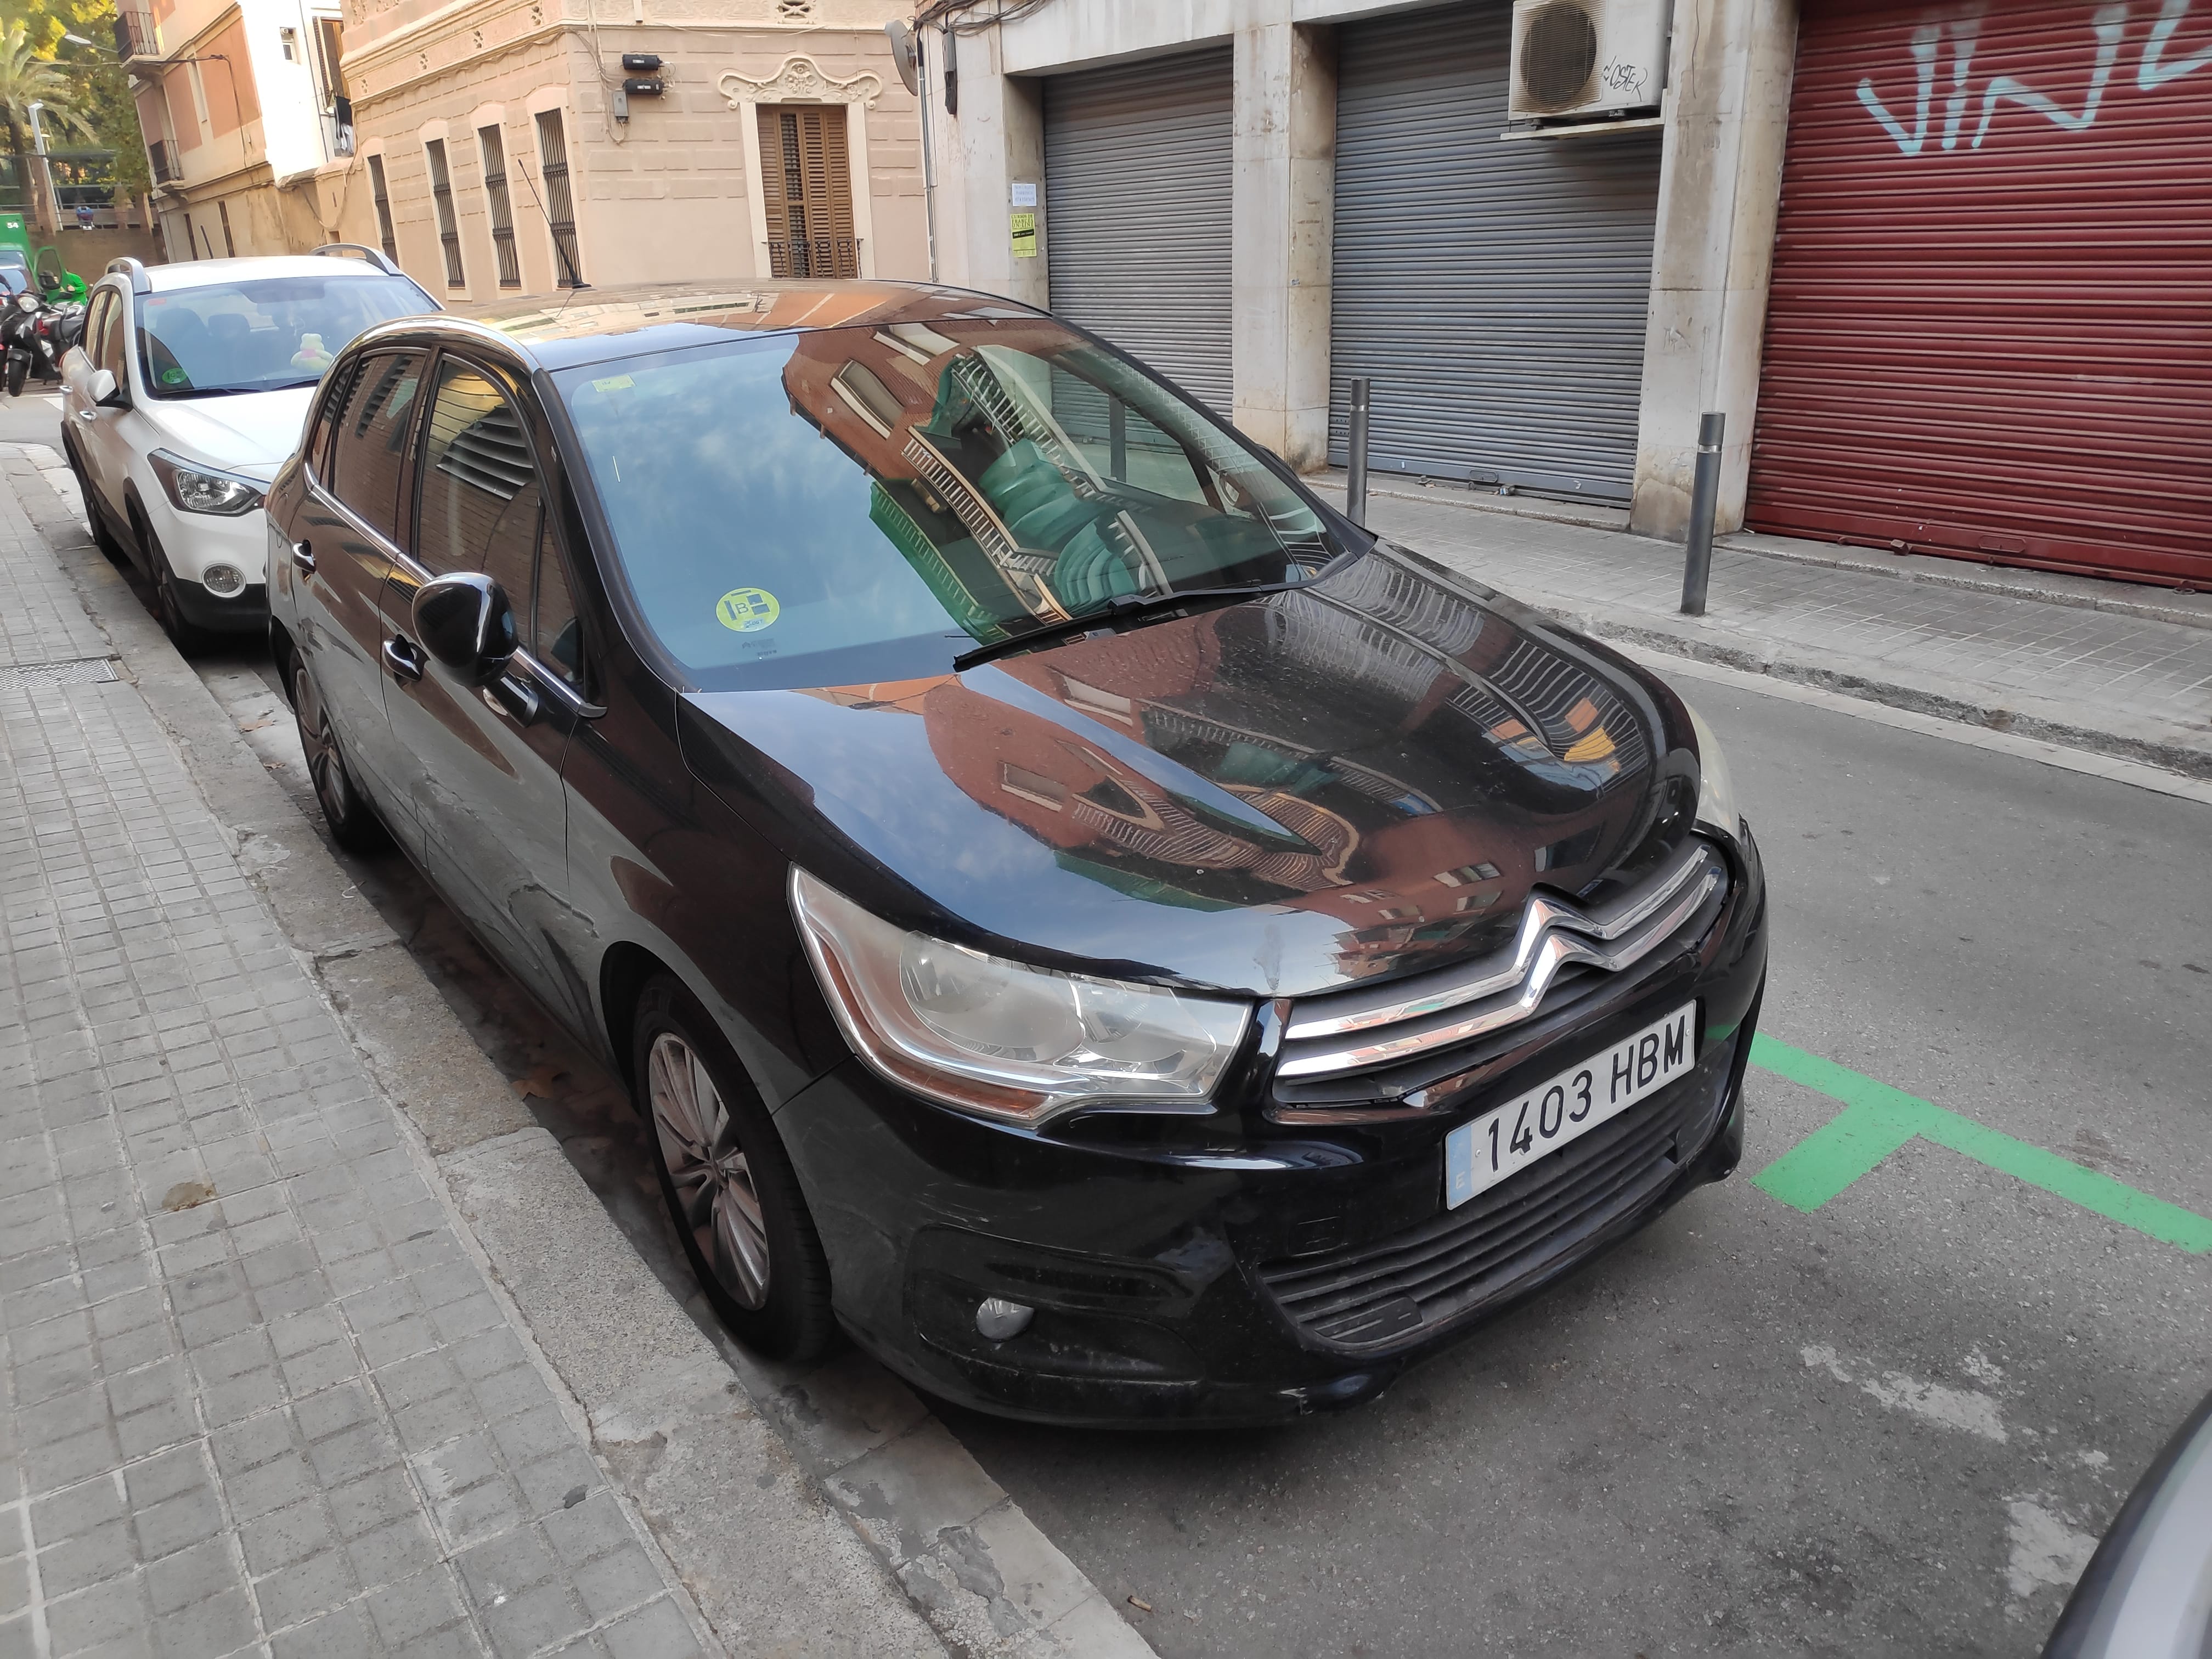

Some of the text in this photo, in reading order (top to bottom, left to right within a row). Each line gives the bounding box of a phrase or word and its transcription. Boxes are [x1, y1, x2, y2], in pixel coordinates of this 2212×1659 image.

[735, 602, 749, 614] B
[1488, 1014, 1685, 1172] 1403 HBM
[1455, 1171, 1466, 1189] E
